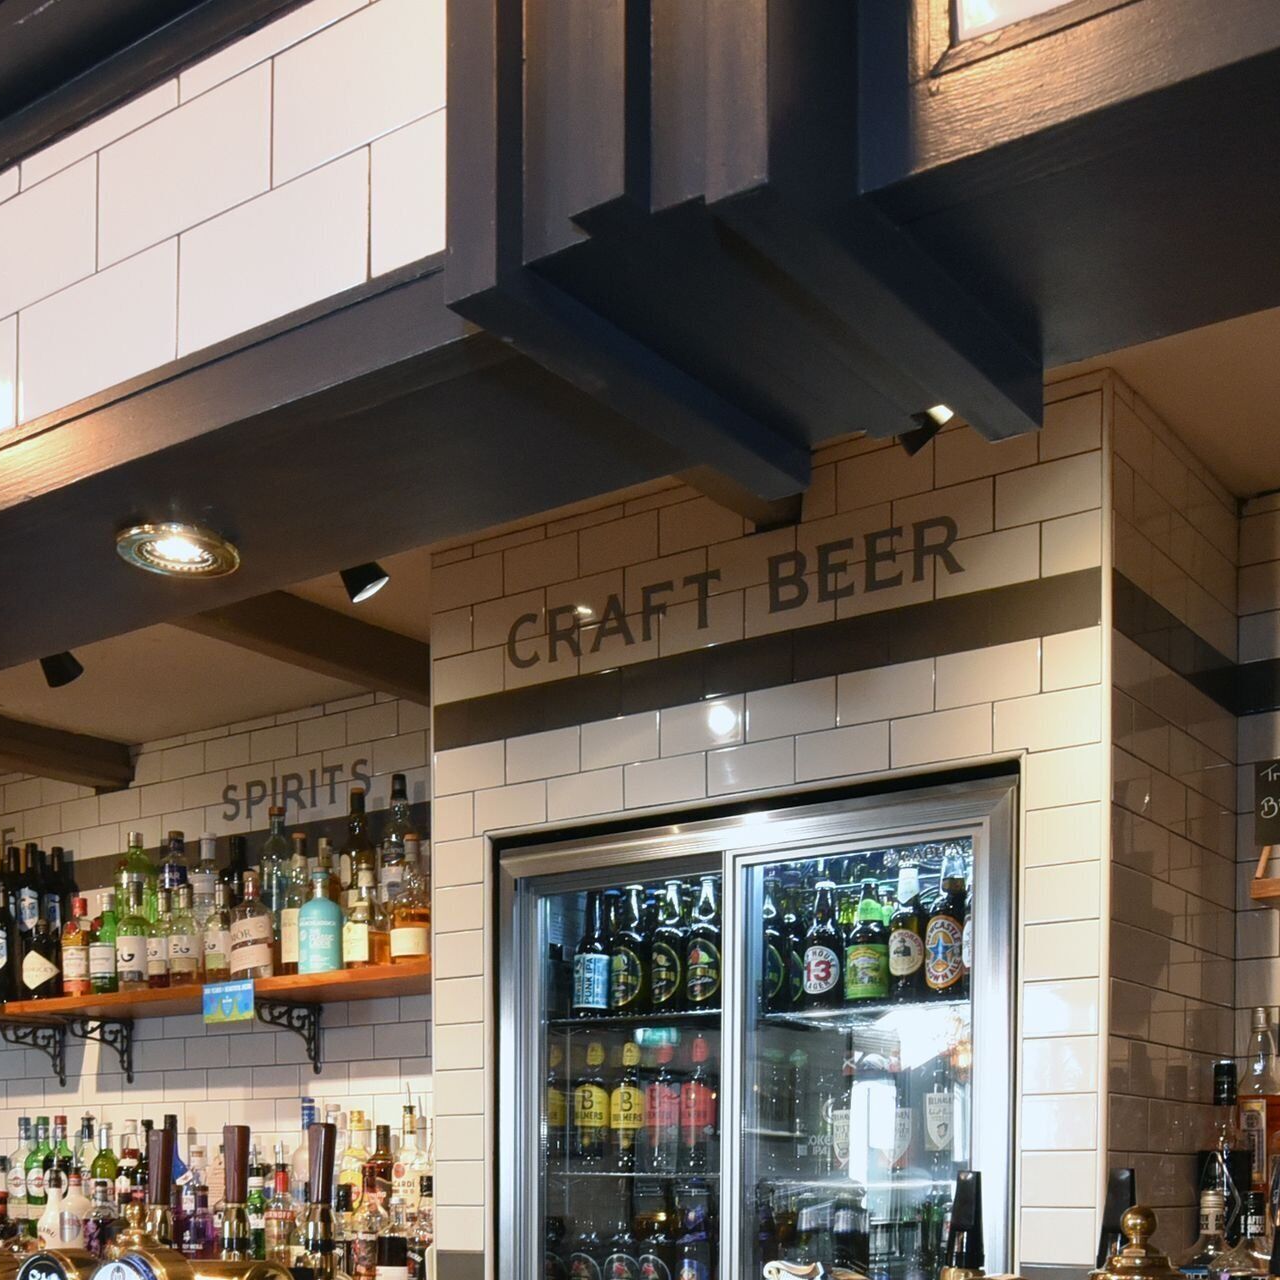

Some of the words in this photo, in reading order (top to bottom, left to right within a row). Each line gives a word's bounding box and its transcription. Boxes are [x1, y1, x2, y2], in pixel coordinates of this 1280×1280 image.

[507, 569, 722, 670] CRAFT
[767, 515, 965, 614] BEER
[222, 758, 372, 822] SPIRITS
[585, 957, 594, 977] IPA
[805, 960, 832, 981] 13
[585, 977, 594, 1004] PUNK
